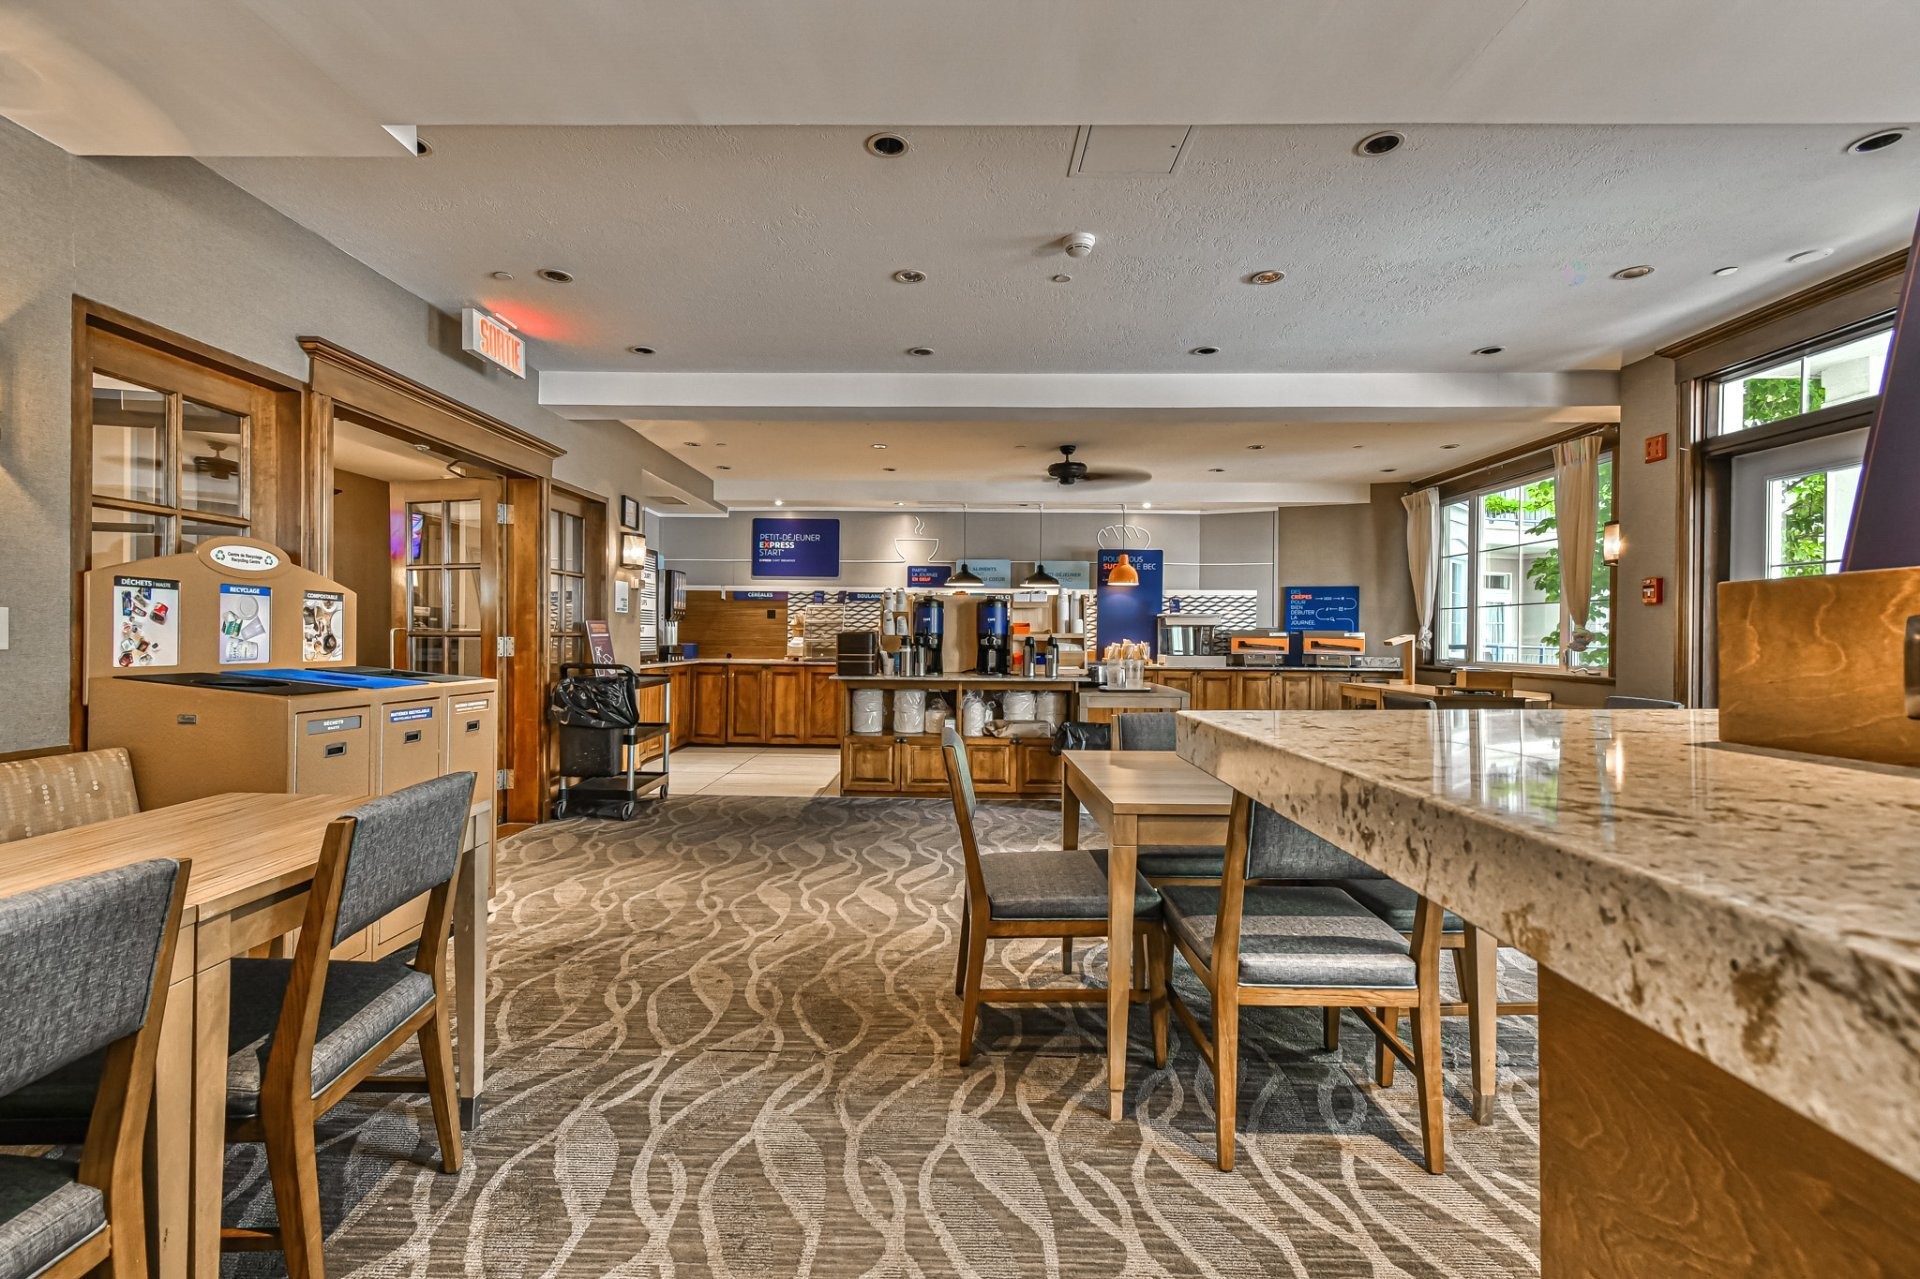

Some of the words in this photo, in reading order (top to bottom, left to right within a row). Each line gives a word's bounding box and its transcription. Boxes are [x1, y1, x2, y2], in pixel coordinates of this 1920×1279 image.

[480, 318, 521, 373] SORTIE
[760, 533, 821, 542] PETIT-DÉJEUNER
[759, 541, 795, 549] EXPRESS
[1142, 563, 1157, 571] BEC
[121, 578, 153, 587] DÉCHETS
[229, 586, 260, 594] RECYCLAGE
